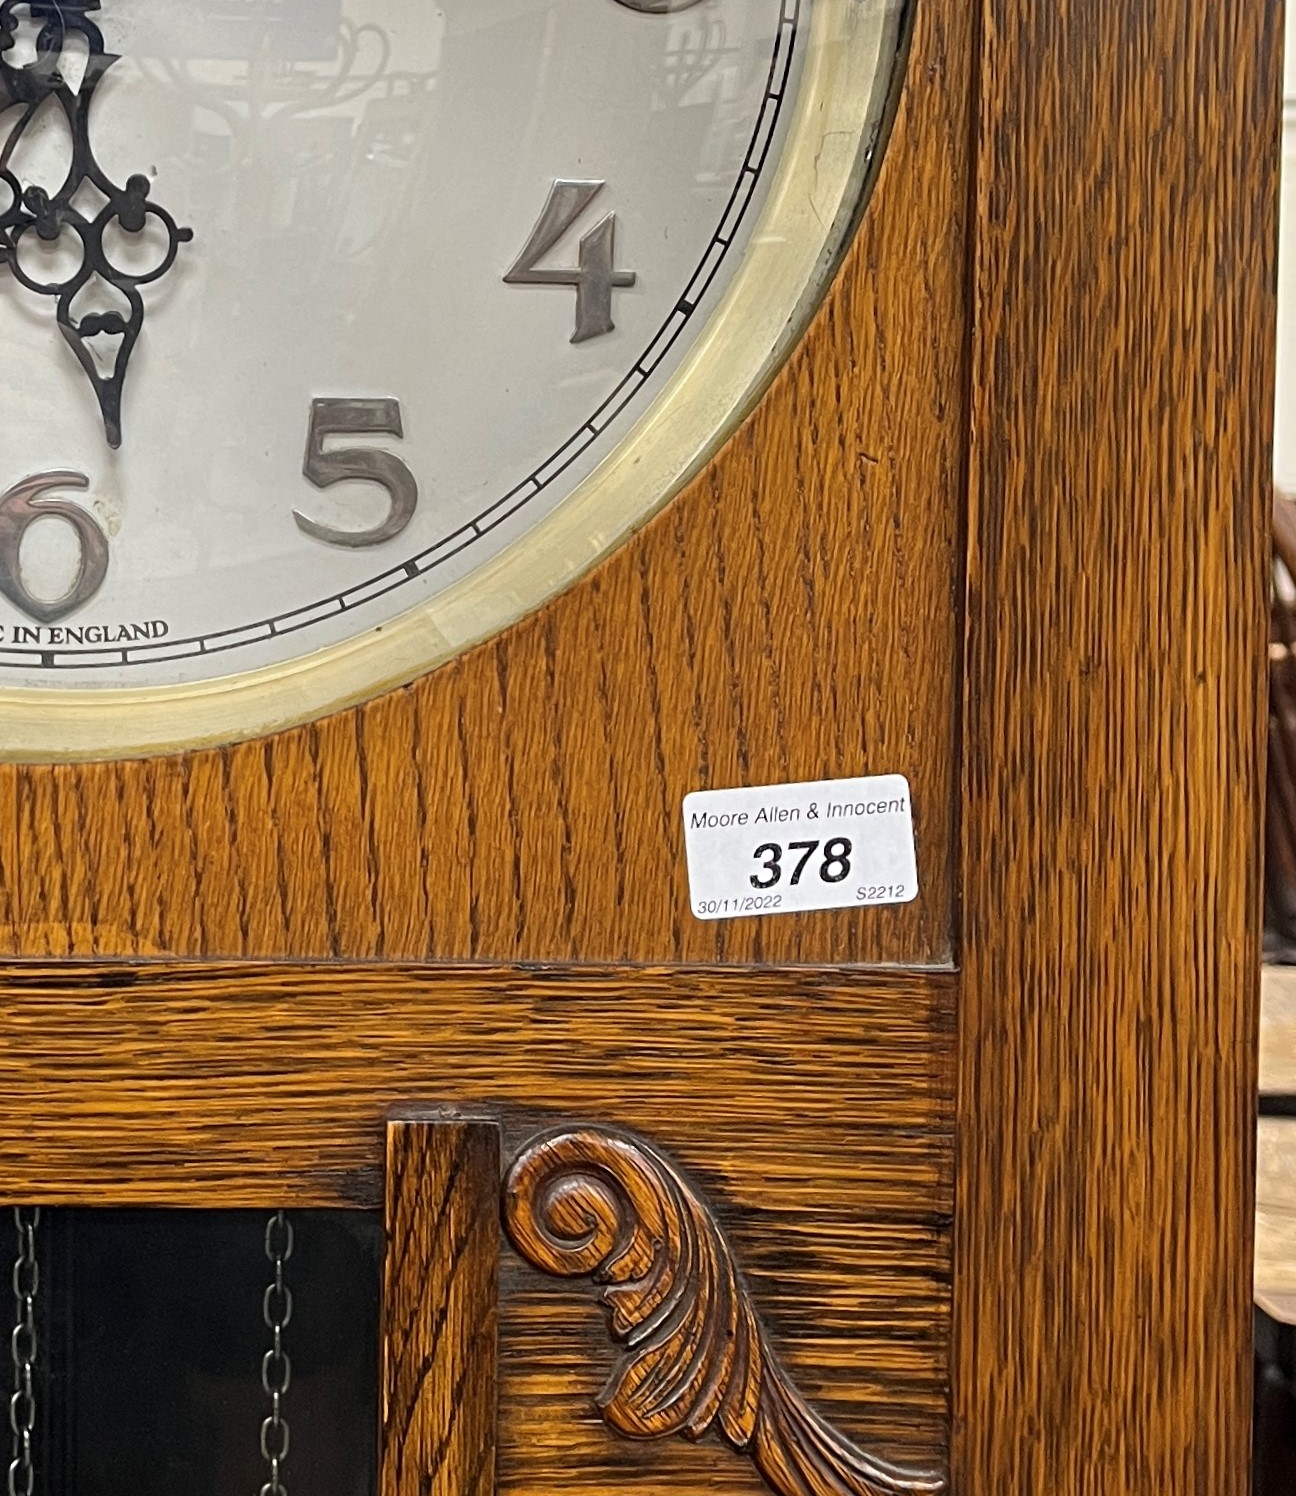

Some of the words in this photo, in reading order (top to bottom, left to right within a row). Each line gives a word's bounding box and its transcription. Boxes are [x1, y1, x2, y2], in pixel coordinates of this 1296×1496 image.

[503, 179, 636, 343] 4
[292, 397, 418, 548] 5
[12, 626, 41, 644] IN
[47, 619, 169, 645] ENGLAND
[690, 811, 749, 830] Moore
[754, 806, 800, 824] Allen
[807, 802, 819, 819] &
[826, 797, 906, 819] Innocent
[749, 837, 853, 889] 378
[697, 894, 783, 915] 30/11/2022
[855, 884, 905, 901] S2212
